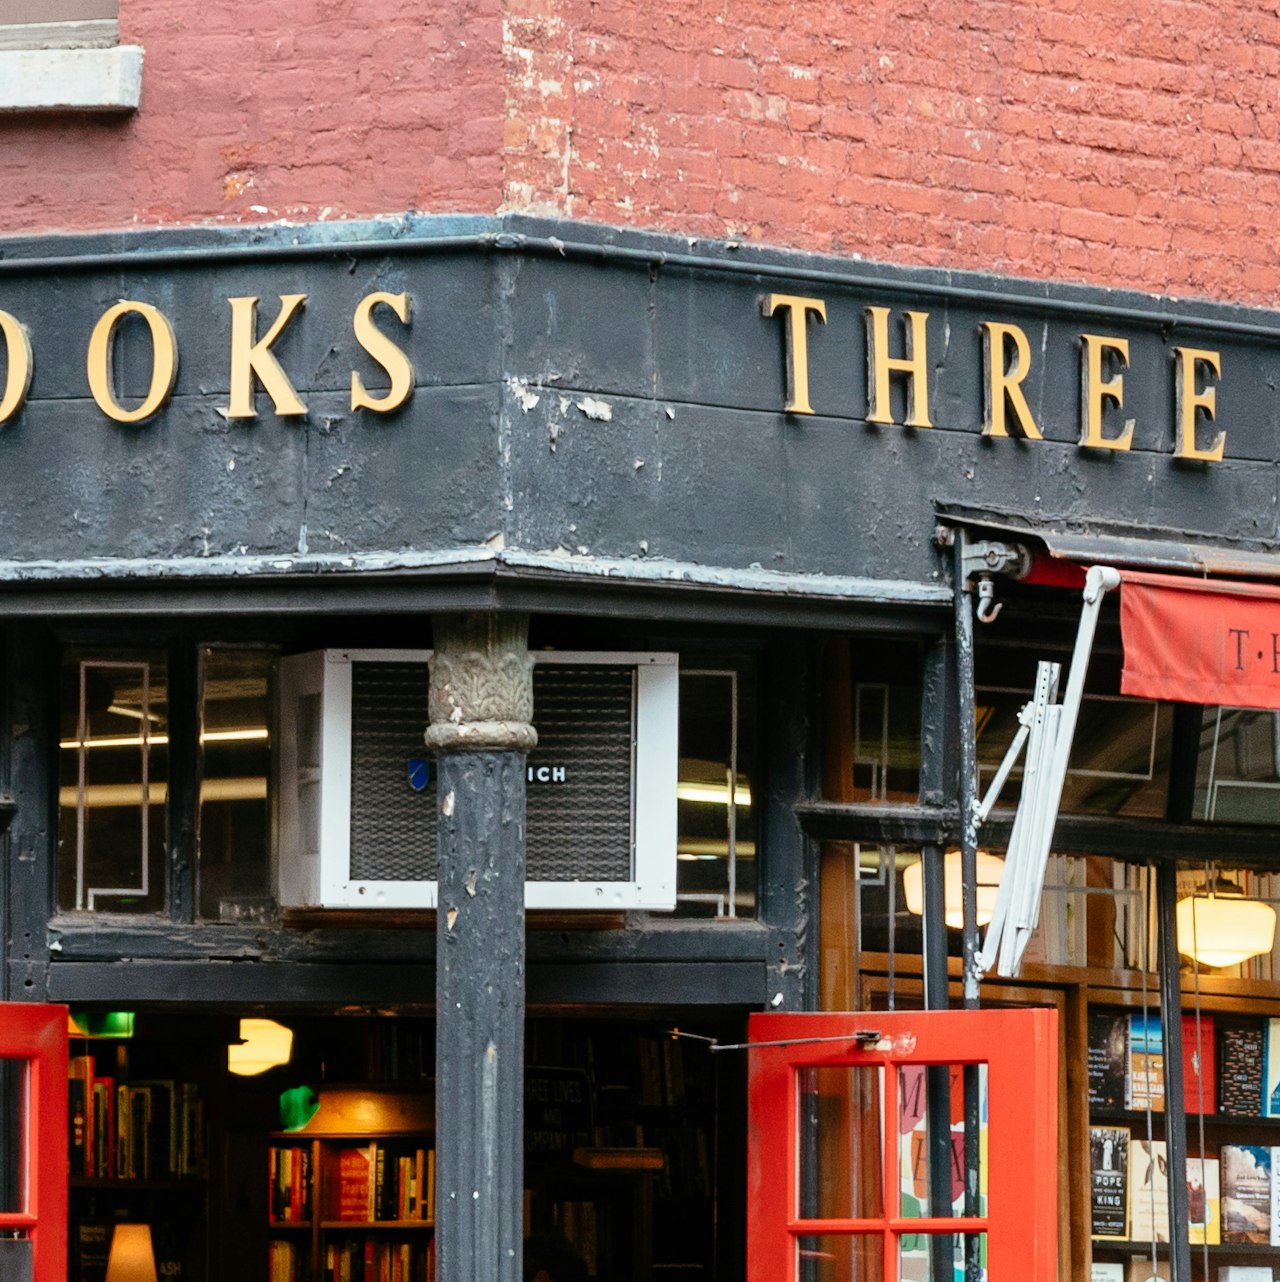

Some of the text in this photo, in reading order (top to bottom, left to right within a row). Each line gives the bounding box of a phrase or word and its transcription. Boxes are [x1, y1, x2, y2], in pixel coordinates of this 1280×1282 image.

[761, 292, 1227, 462] THREE
[1095, 1175, 1123, 1187] POPE
[1096, 1195, 1121, 1206] KING
